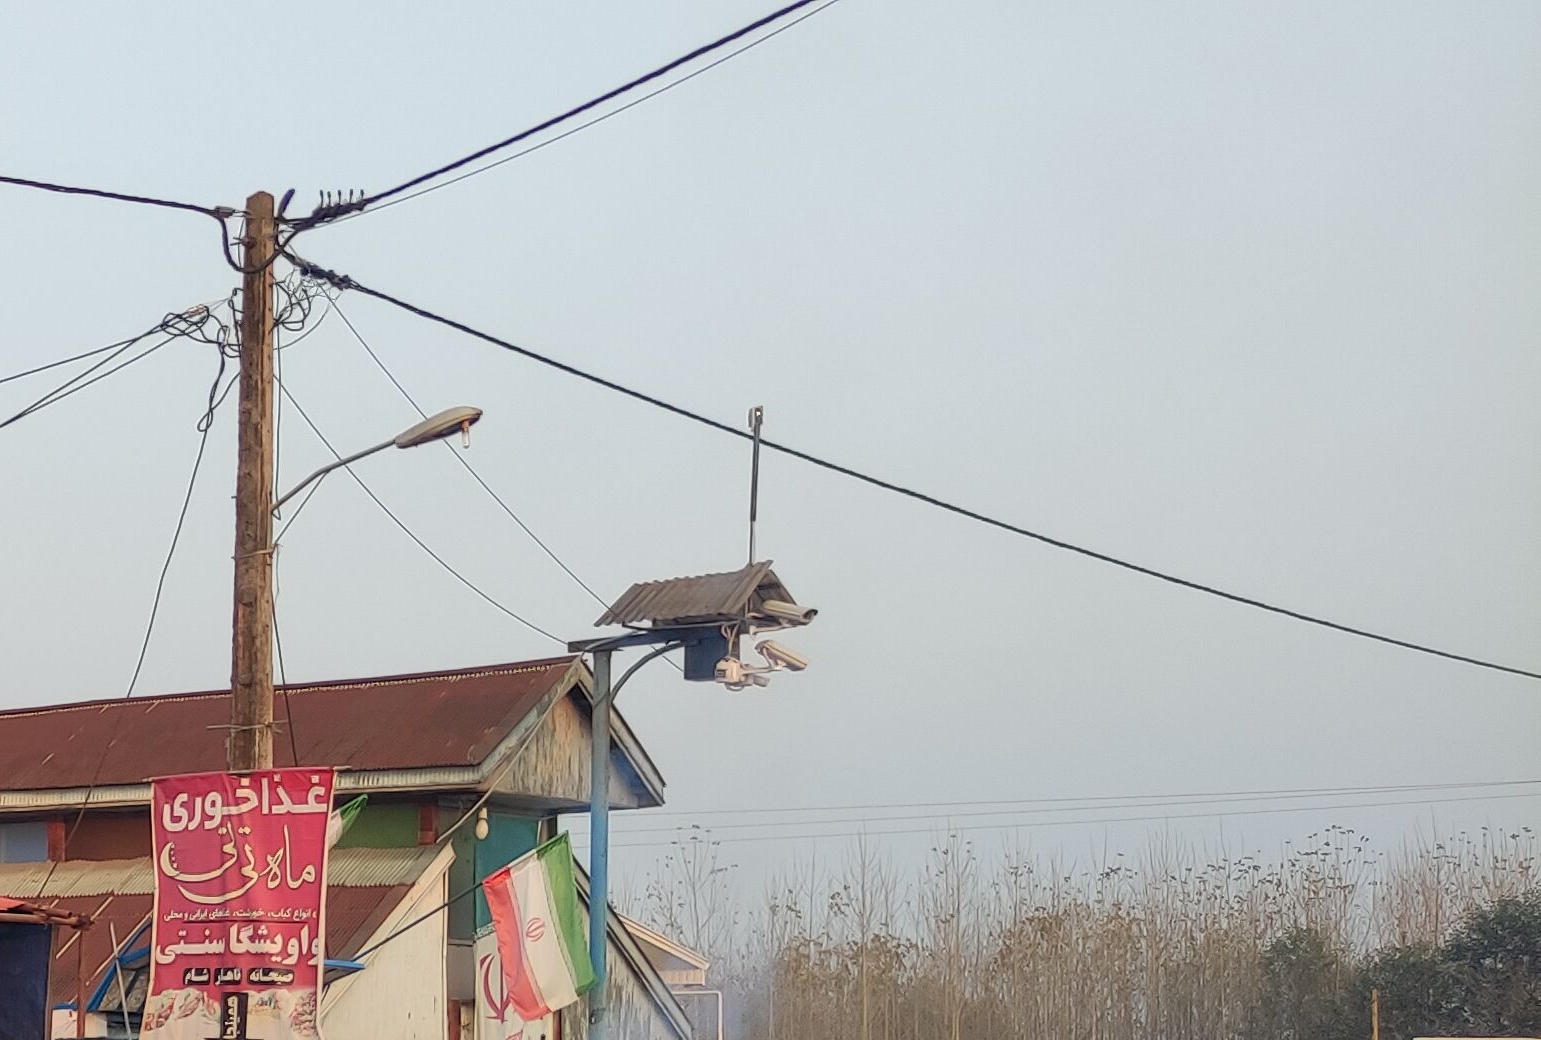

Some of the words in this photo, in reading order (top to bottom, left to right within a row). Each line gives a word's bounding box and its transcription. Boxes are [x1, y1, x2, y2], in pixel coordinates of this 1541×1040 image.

[162, 775, 328, 832] غذاخوری
[267, 824, 316, 890] ماه
[155, 928, 226, 965] سنتی
[184, 967, 209, 986] شام
[214, 967, 242, 986] ناهار
[248, 967, 295, 986] صبحانه
